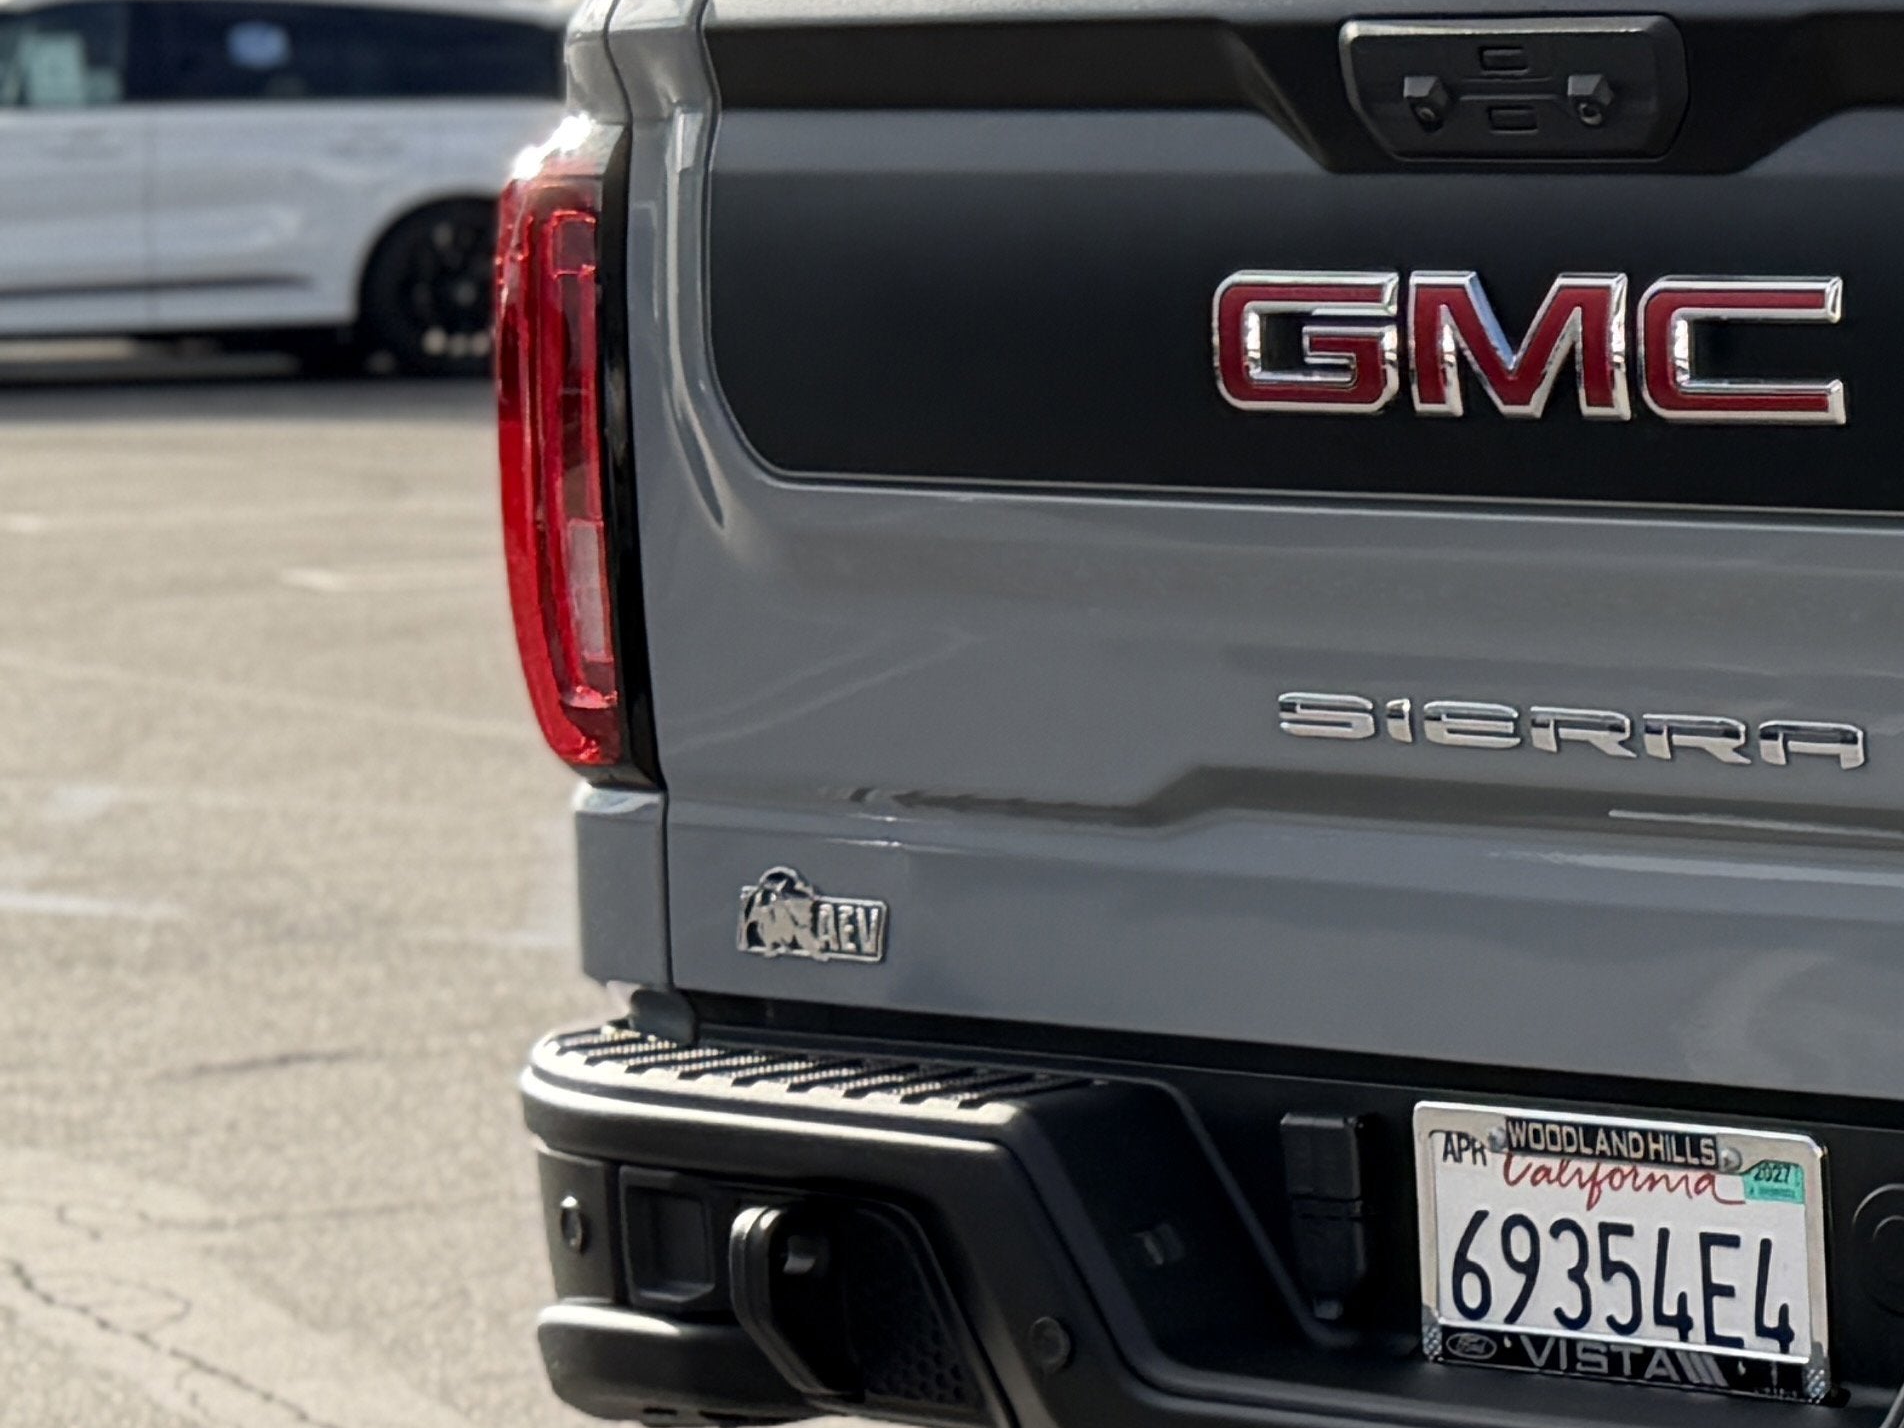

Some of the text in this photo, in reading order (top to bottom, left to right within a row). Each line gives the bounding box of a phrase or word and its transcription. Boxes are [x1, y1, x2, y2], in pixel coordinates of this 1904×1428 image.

[1212, 270, 1847, 425] GMC
[1277, 691, 1866, 770] SIERRA
[817, 903, 880, 955] AEV
[1442, 1131, 1487, 1166] APR
[1507, 1120, 1717, 1167] WOODLAND HILLS
[1503, 1153, 1746, 1212] California
[1753, 1164, 1791, 1184] 2027
[1452, 1209, 1795, 1355] 69354E4
[1519, 1334, 1682, 1383] VISTA
